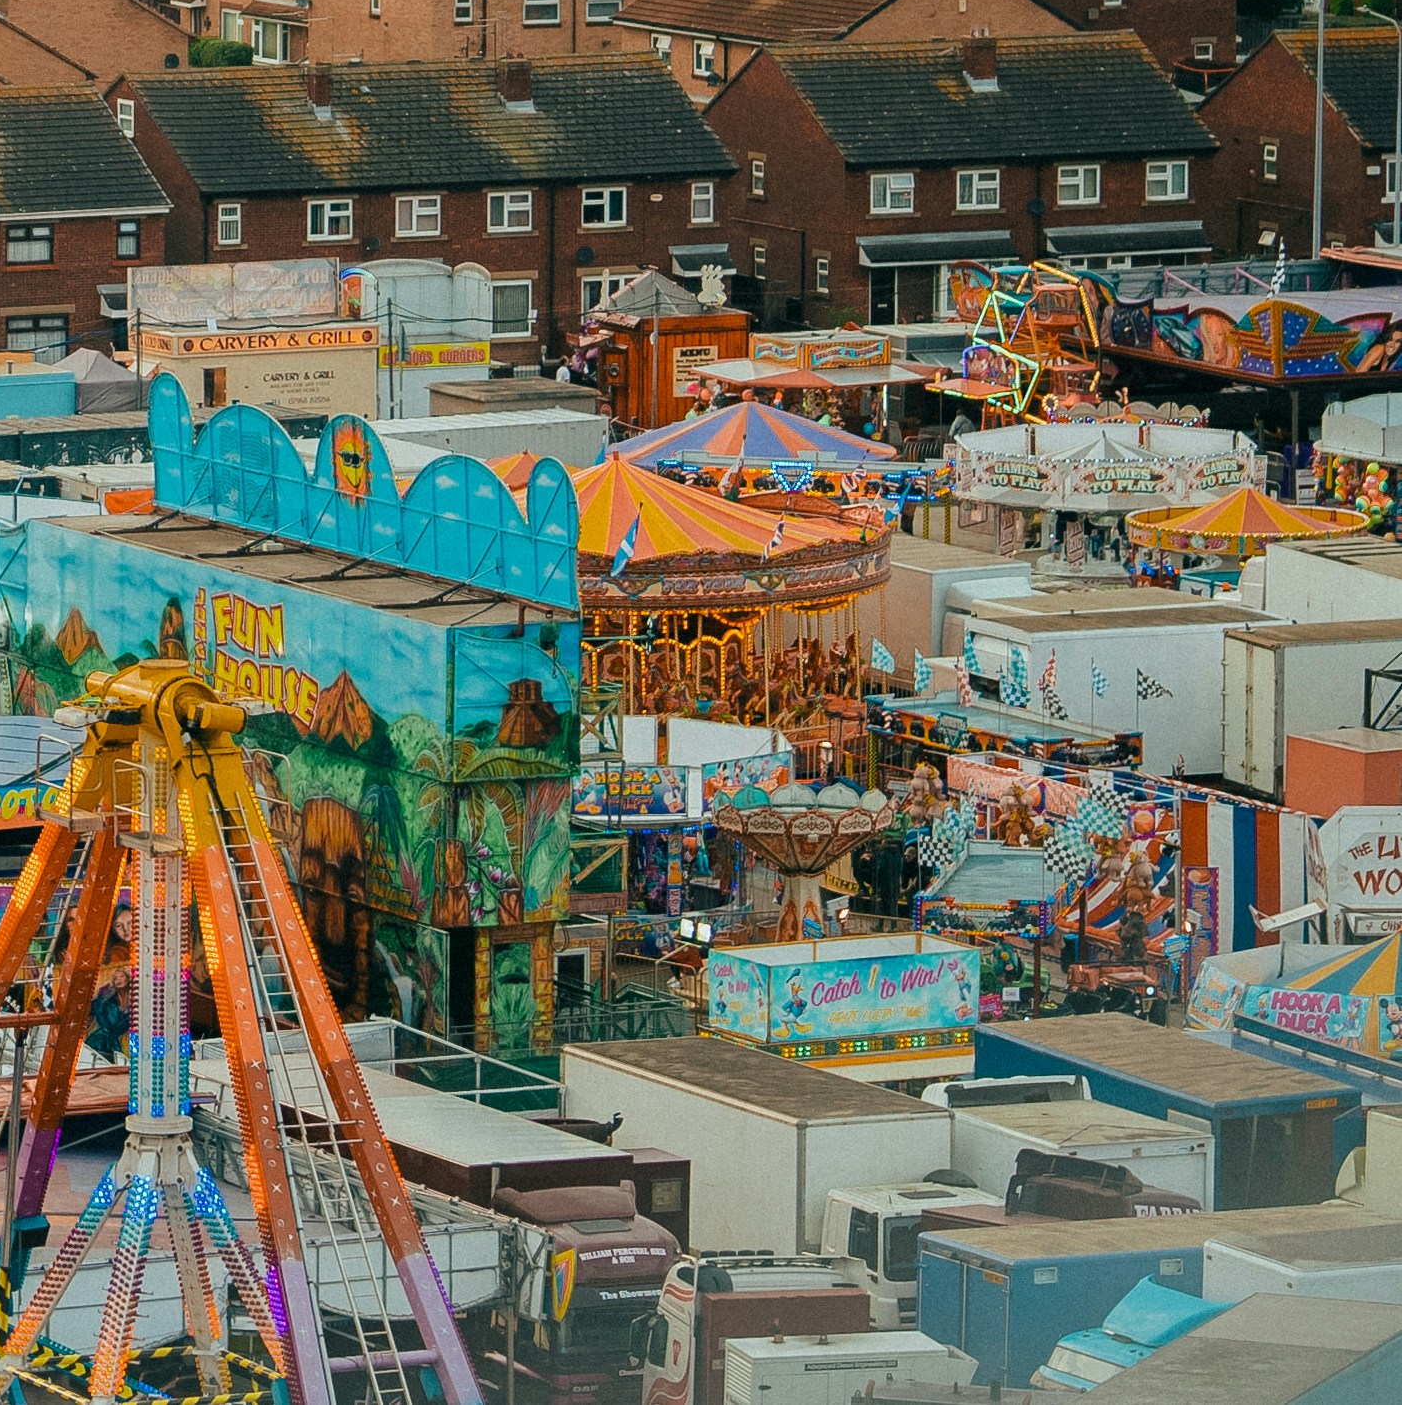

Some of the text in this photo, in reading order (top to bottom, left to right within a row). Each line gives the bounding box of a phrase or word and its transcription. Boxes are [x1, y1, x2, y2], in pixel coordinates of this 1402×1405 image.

[199, 330, 357, 352] CARVERY & GRILL
[680, 349, 711, 357] MENU
[262, 371, 336, 382] CARVERY & GRILL
[995, 461, 1039, 478] GAMES
[1094, 466, 1151, 480] GAMES
[1203, 459, 1238, 475] GAMES
[991, 474, 1044, 490] TO PLAY
[1091, 479, 1156, 493] TO PLAY
[1200, 470, 1243, 488] TO PLAY
[194, 586, 207, 679] JUNGL
[211, 591, 285, 658] FUN
[213, 646, 320, 731] HOUSE
[595, 770, 662, 784] HOOK A
[1348, 834, 1402, 862] THE LI
[713, 962, 733, 978] Catch
[728, 978, 750, 994] to Win!
[811, 970, 863, 1007] Catch
[880, 979, 897, 1000] to
[900, 958, 945, 993] Win!
[1270, 991, 1341, 1015] HOOK A
[1277, 1011, 1330, 1035] DUCK
[579, 1249, 613, 1262] WILLIAM
[620, 1255, 636, 1264] SON
[599, 1291, 618, 1301] The
